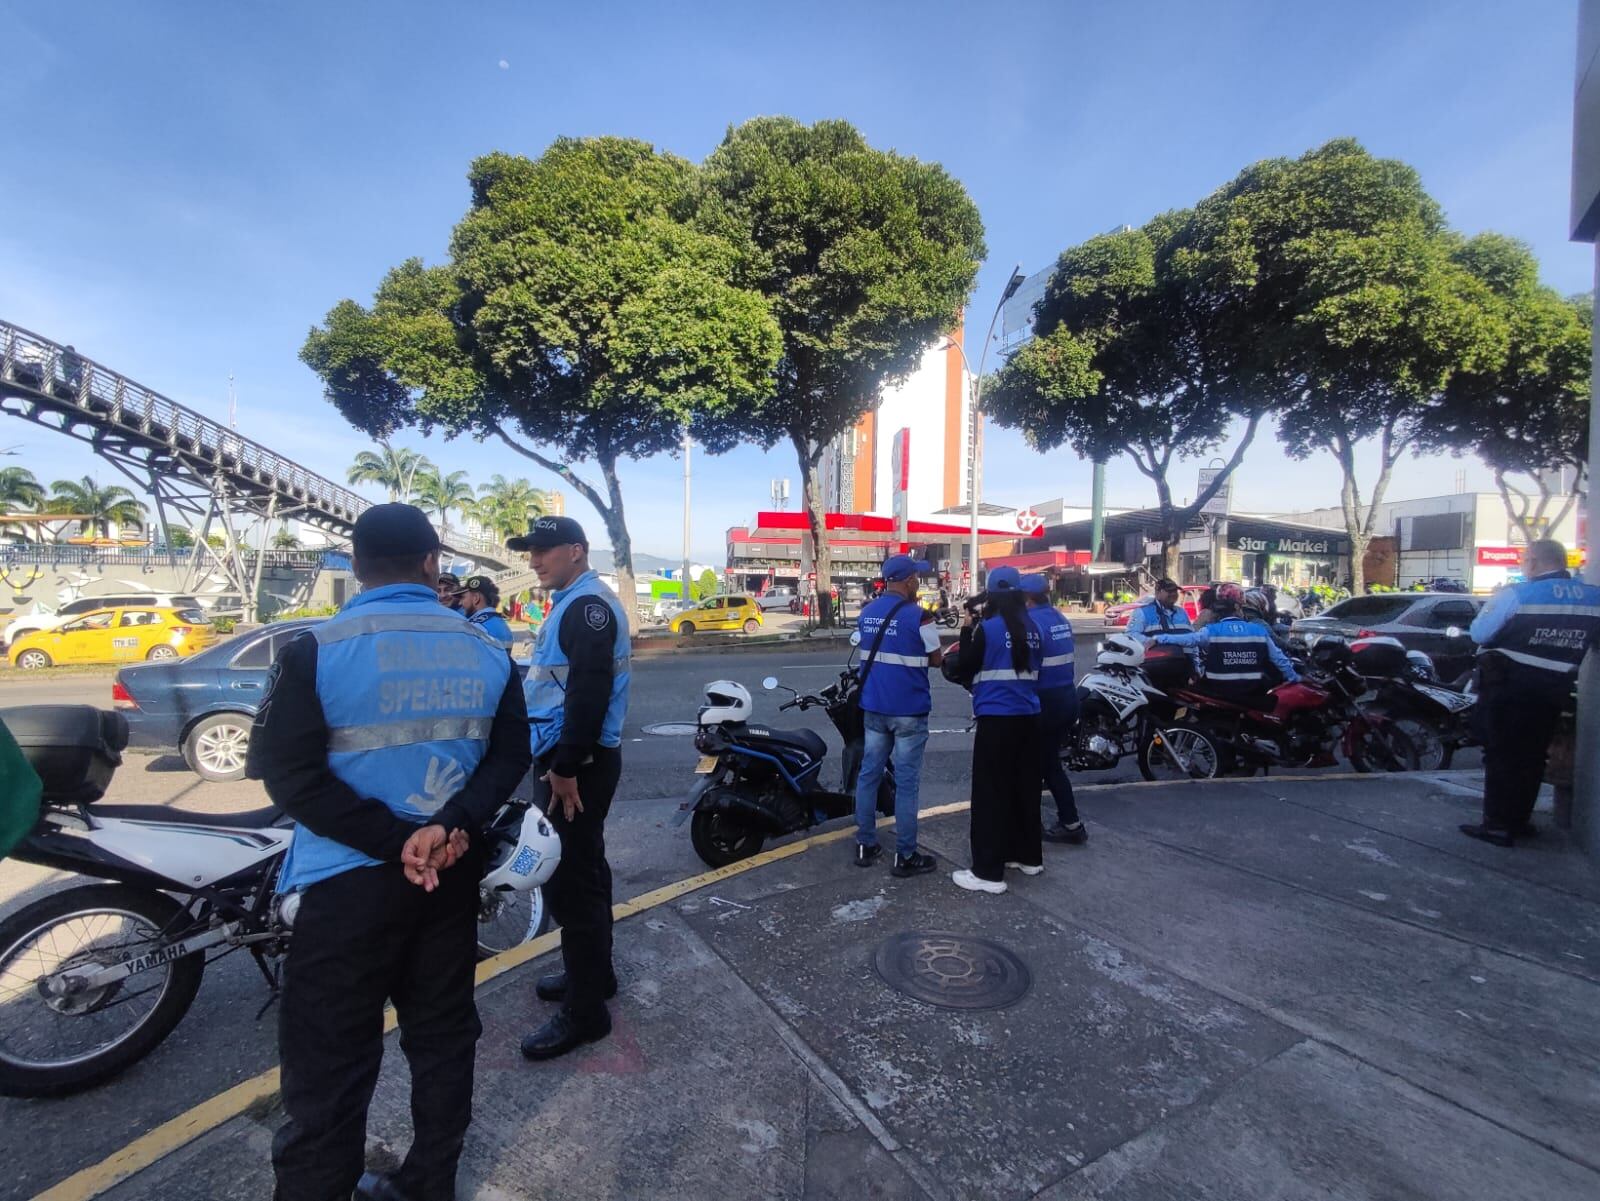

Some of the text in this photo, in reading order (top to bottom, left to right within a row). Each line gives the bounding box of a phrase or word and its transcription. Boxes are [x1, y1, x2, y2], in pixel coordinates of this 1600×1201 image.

[1238, 537, 1328, 553] Star Market
[1553, 585, 1583, 599] 010
[379, 677, 484, 714] SPEAKER
[126, 943, 187, 975] YAMAHA
